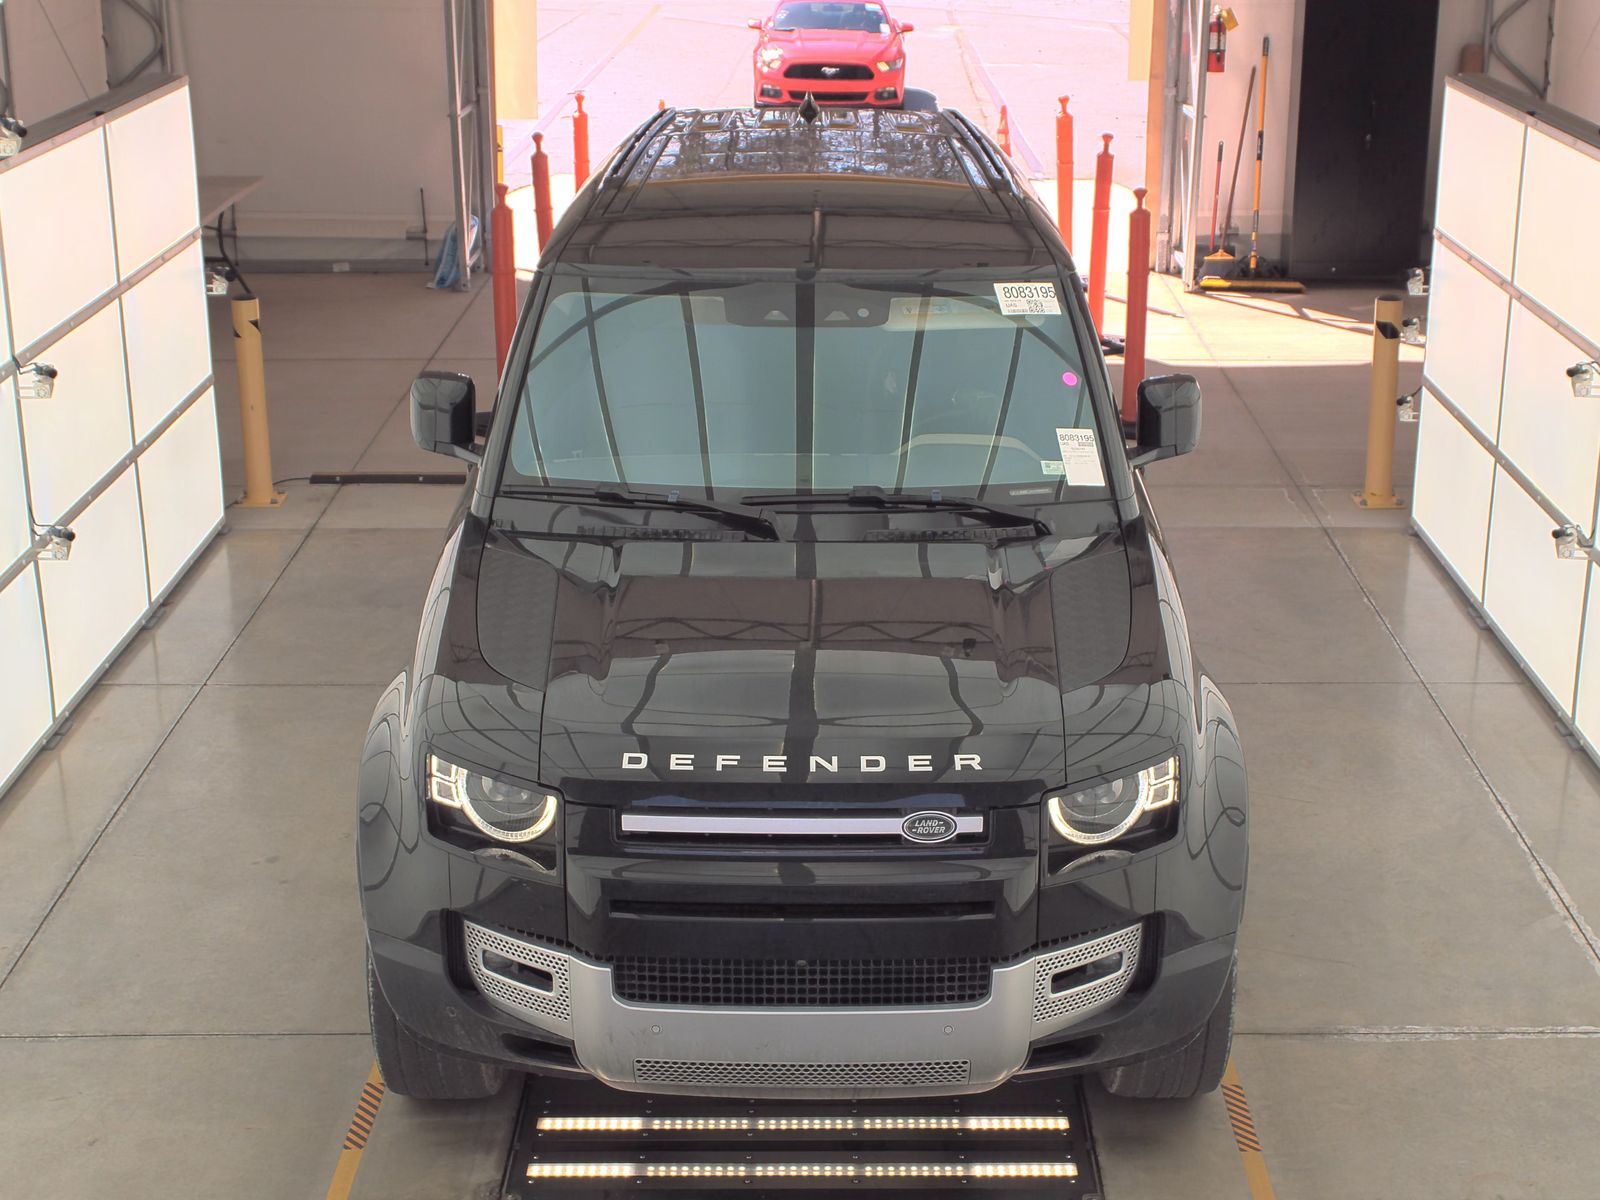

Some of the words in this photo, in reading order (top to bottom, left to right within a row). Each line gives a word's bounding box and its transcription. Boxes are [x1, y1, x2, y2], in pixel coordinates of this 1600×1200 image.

[1003, 286, 1056, 299] 8083195
[1059, 433, 1095, 442] 8083195
[622, 752, 983, 772] DEFENDER
